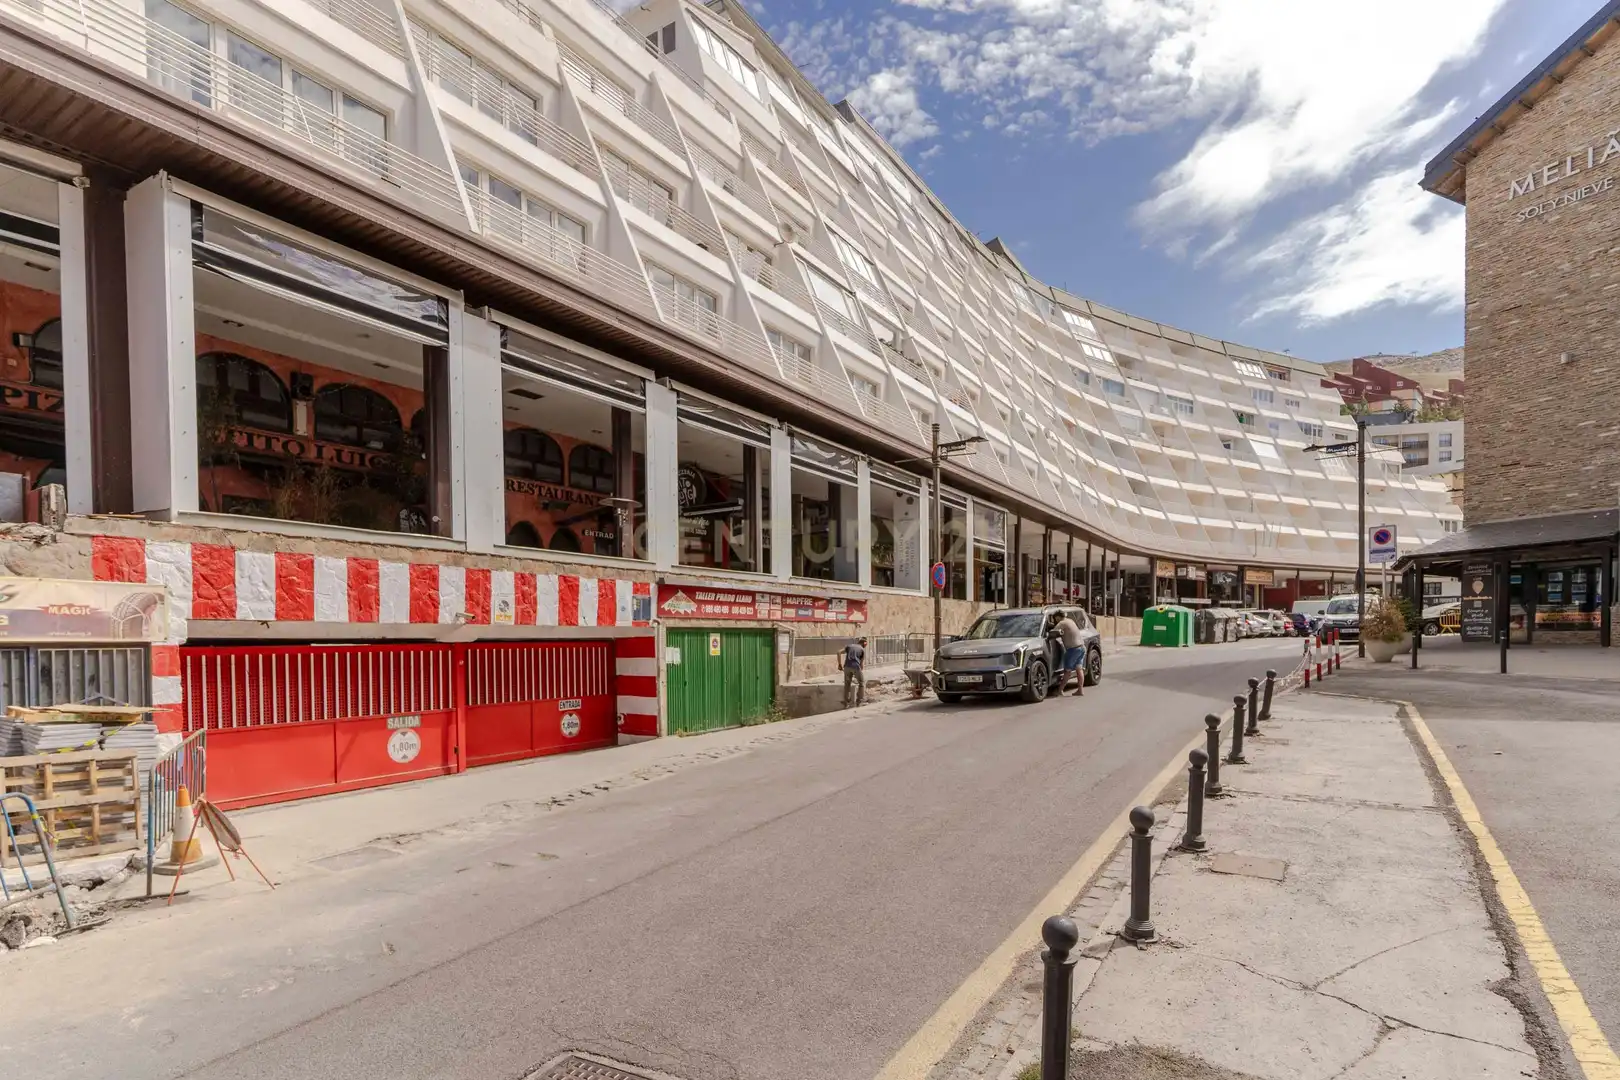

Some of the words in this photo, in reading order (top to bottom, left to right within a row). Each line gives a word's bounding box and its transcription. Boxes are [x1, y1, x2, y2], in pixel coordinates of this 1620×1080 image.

[1517, 203, 1546, 222] SOL
[1564, 176, 1613, 205] NIEVE
[314, 444, 390, 469] LUIG
[584, 529, 614, 540] ENTRAD
[695, 591, 715, 601] TALLER
[716, 593, 735, 603] PRADO
[786, 596, 813, 606] MAPFRE
[560, 700, 581, 709] ENTRADA
[387, 715, 420, 729] SALIDA
